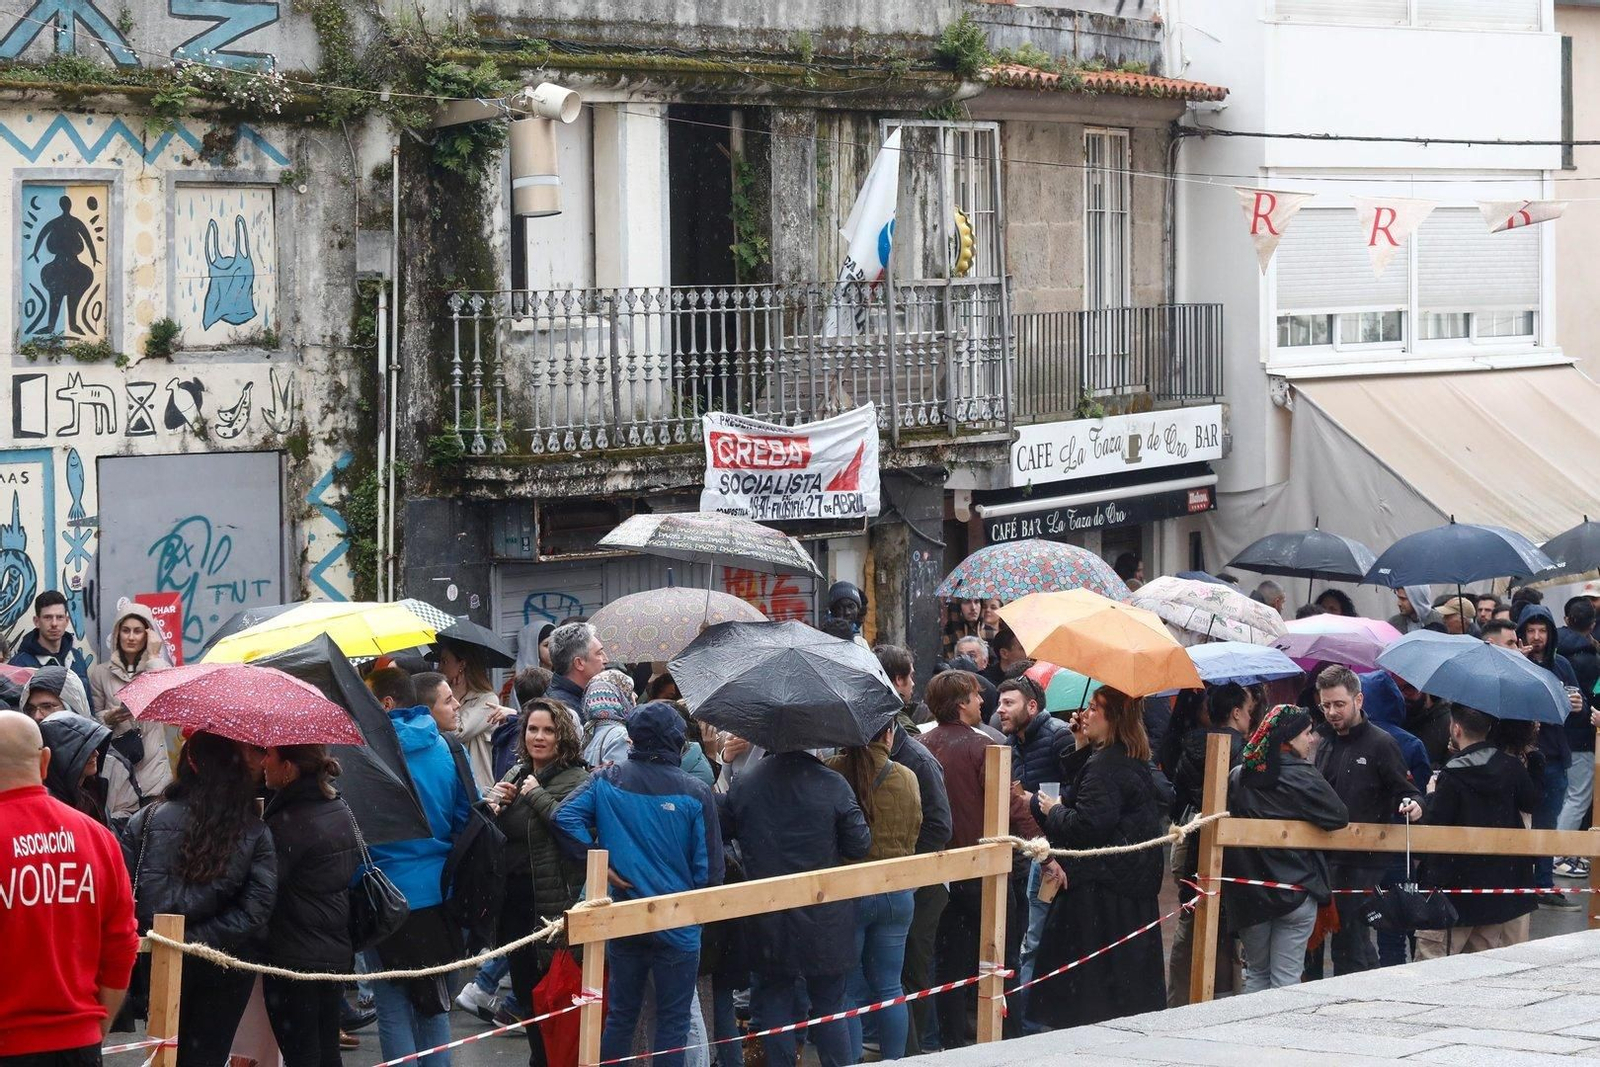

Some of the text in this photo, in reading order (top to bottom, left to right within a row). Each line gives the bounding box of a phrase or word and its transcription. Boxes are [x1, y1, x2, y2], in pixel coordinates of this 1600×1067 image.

[1250, 192, 1279, 235] R
[1368, 207, 1400, 246] R
[716, 435, 804, 467] GREBA
[1017, 422, 1219, 474] CAFE La Taza de Oro BAR
[0, 471, 30, 484] AS
[719, 473, 822, 495] SOCIALISTA
[806, 494, 824, 517] 27
[833, 492, 866, 515] ABRIL
[991, 502, 1127, 541] CAFÉ BAR La Taza de Oro
[206, 579, 271, 605] TNT
[150, 605, 176, 615] CHAR
[12, 826, 75, 858] ASOCIACIÓN
